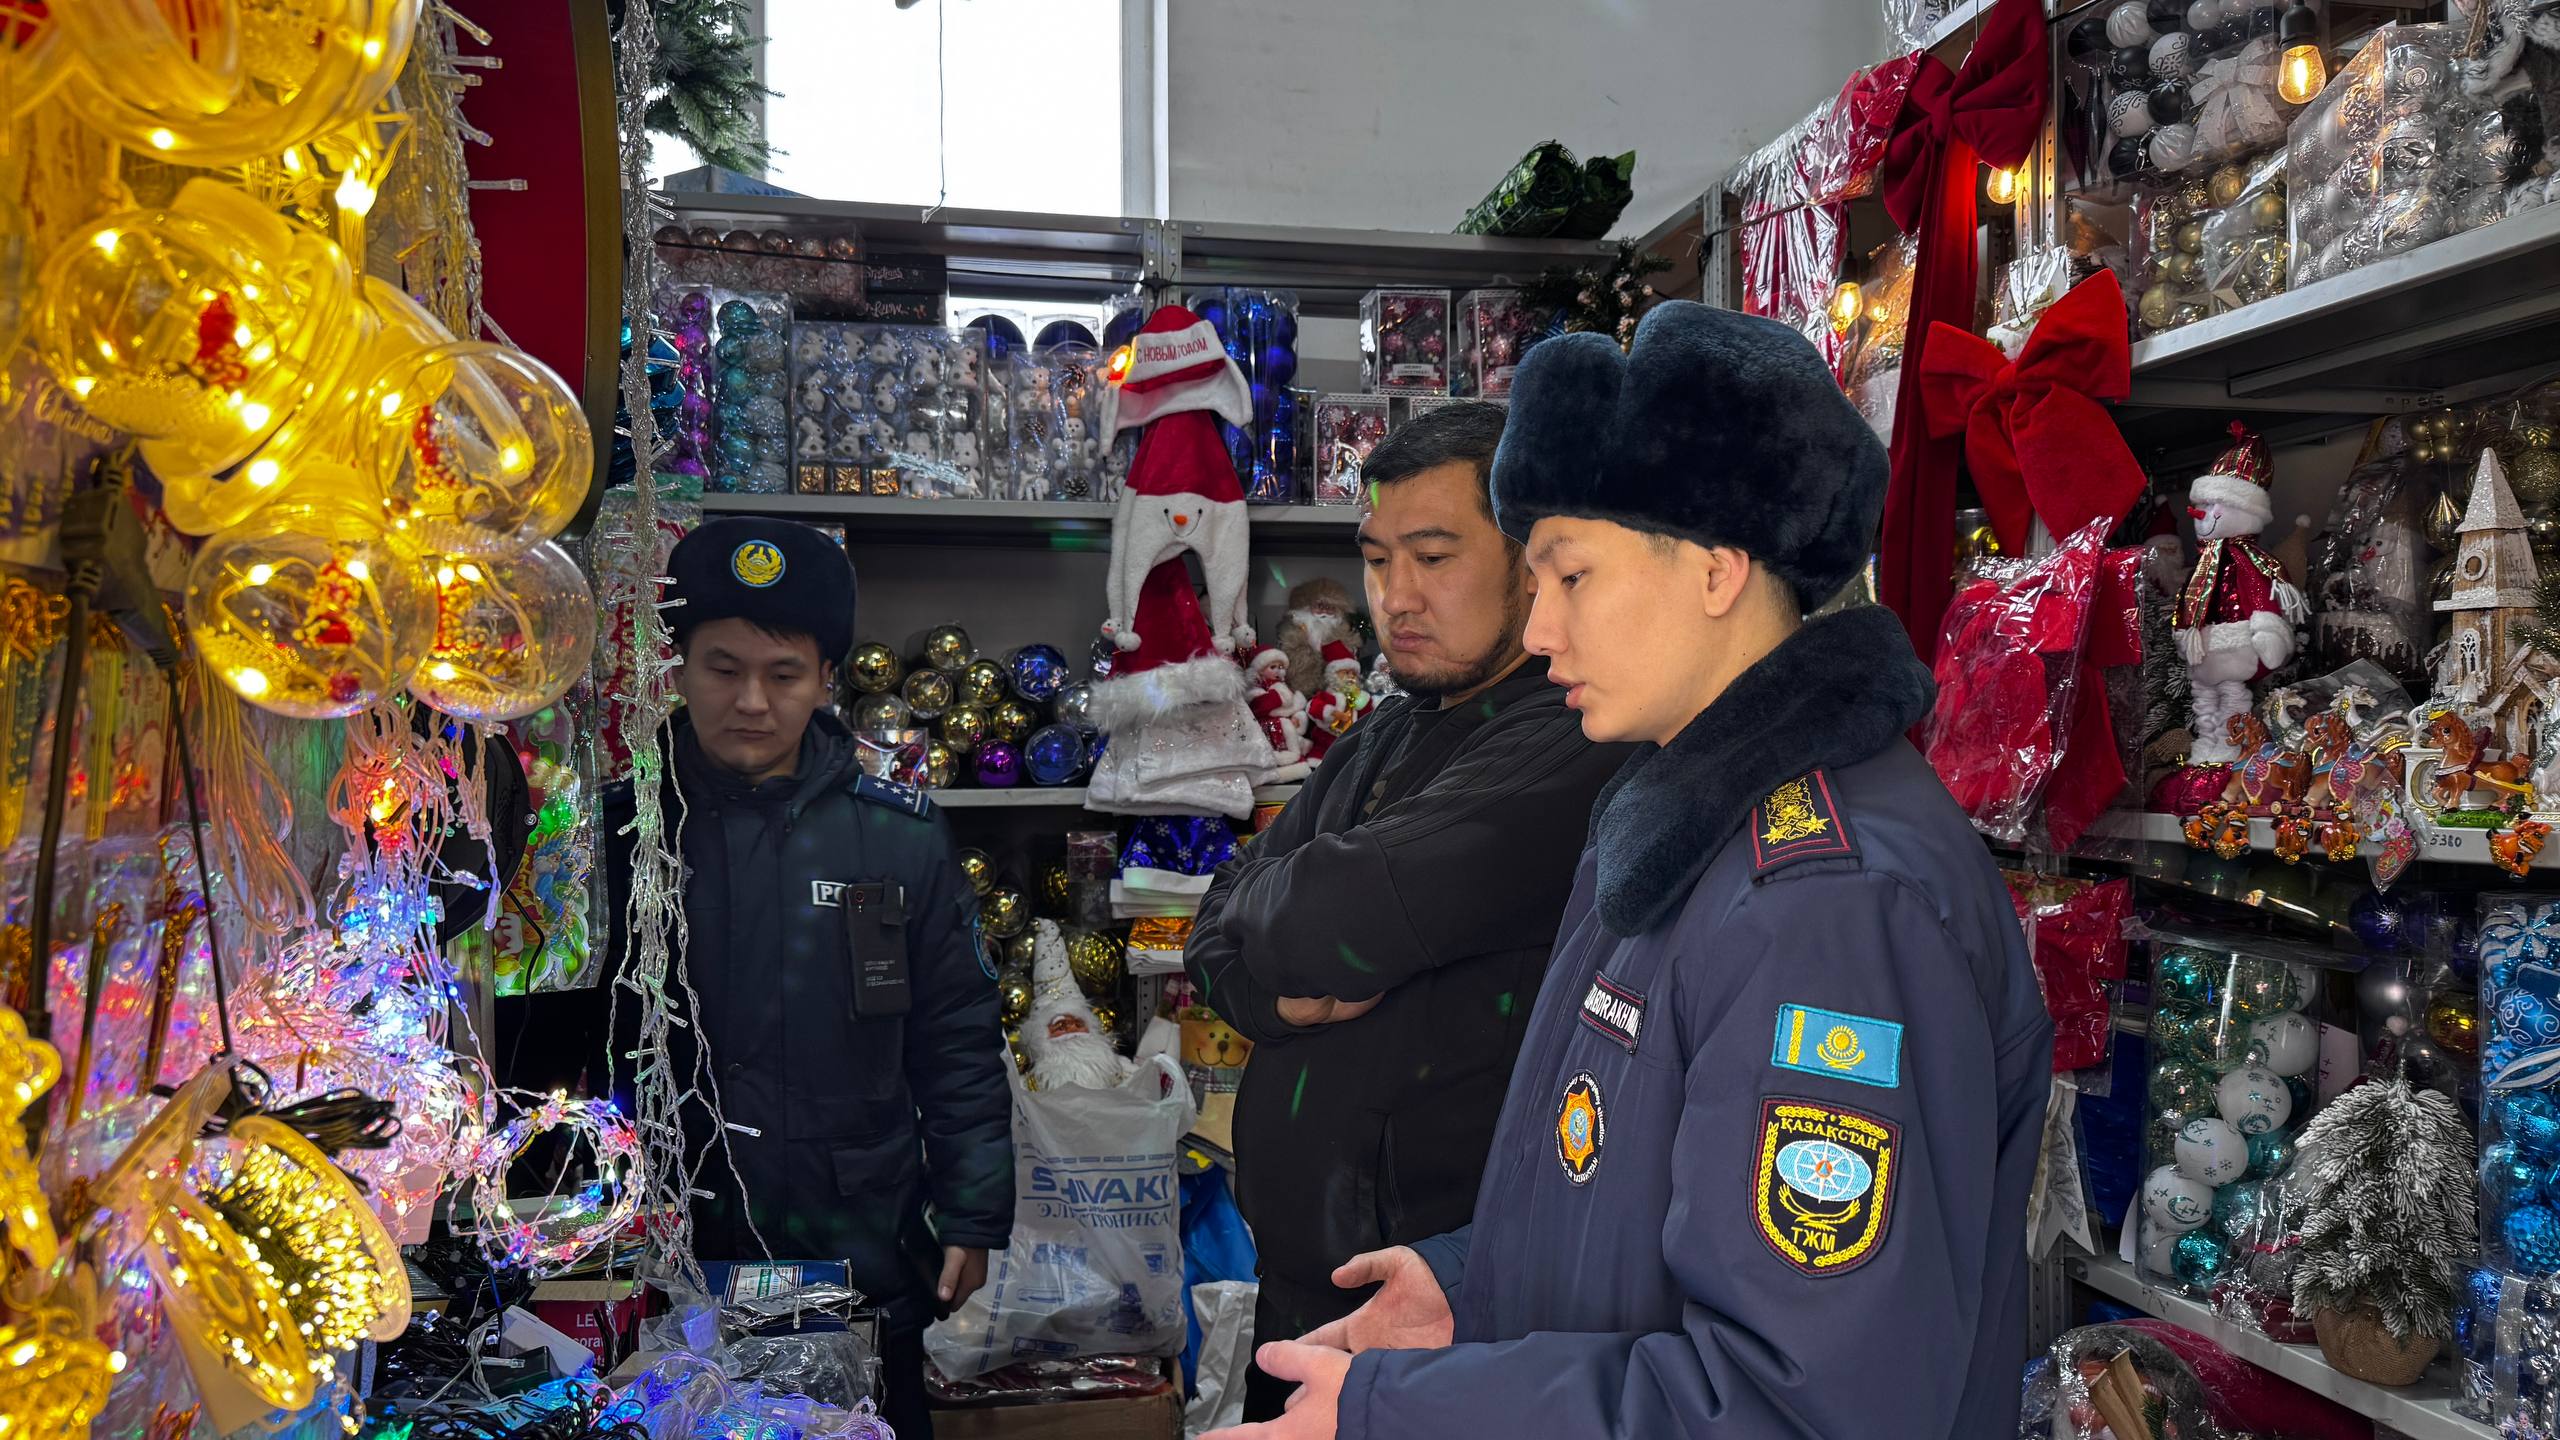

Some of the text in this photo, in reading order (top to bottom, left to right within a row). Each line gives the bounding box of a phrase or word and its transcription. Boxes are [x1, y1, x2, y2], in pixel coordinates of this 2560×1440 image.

[1144, 344, 1177, 362] НОВЫМ
[1780, 1117, 1880, 1151] ҚАЗАҚСТАН
[1038, 1203, 1170, 1229] ЭЛТРОНИКА
[1791, 1226, 1836, 1253] ТЖМ
